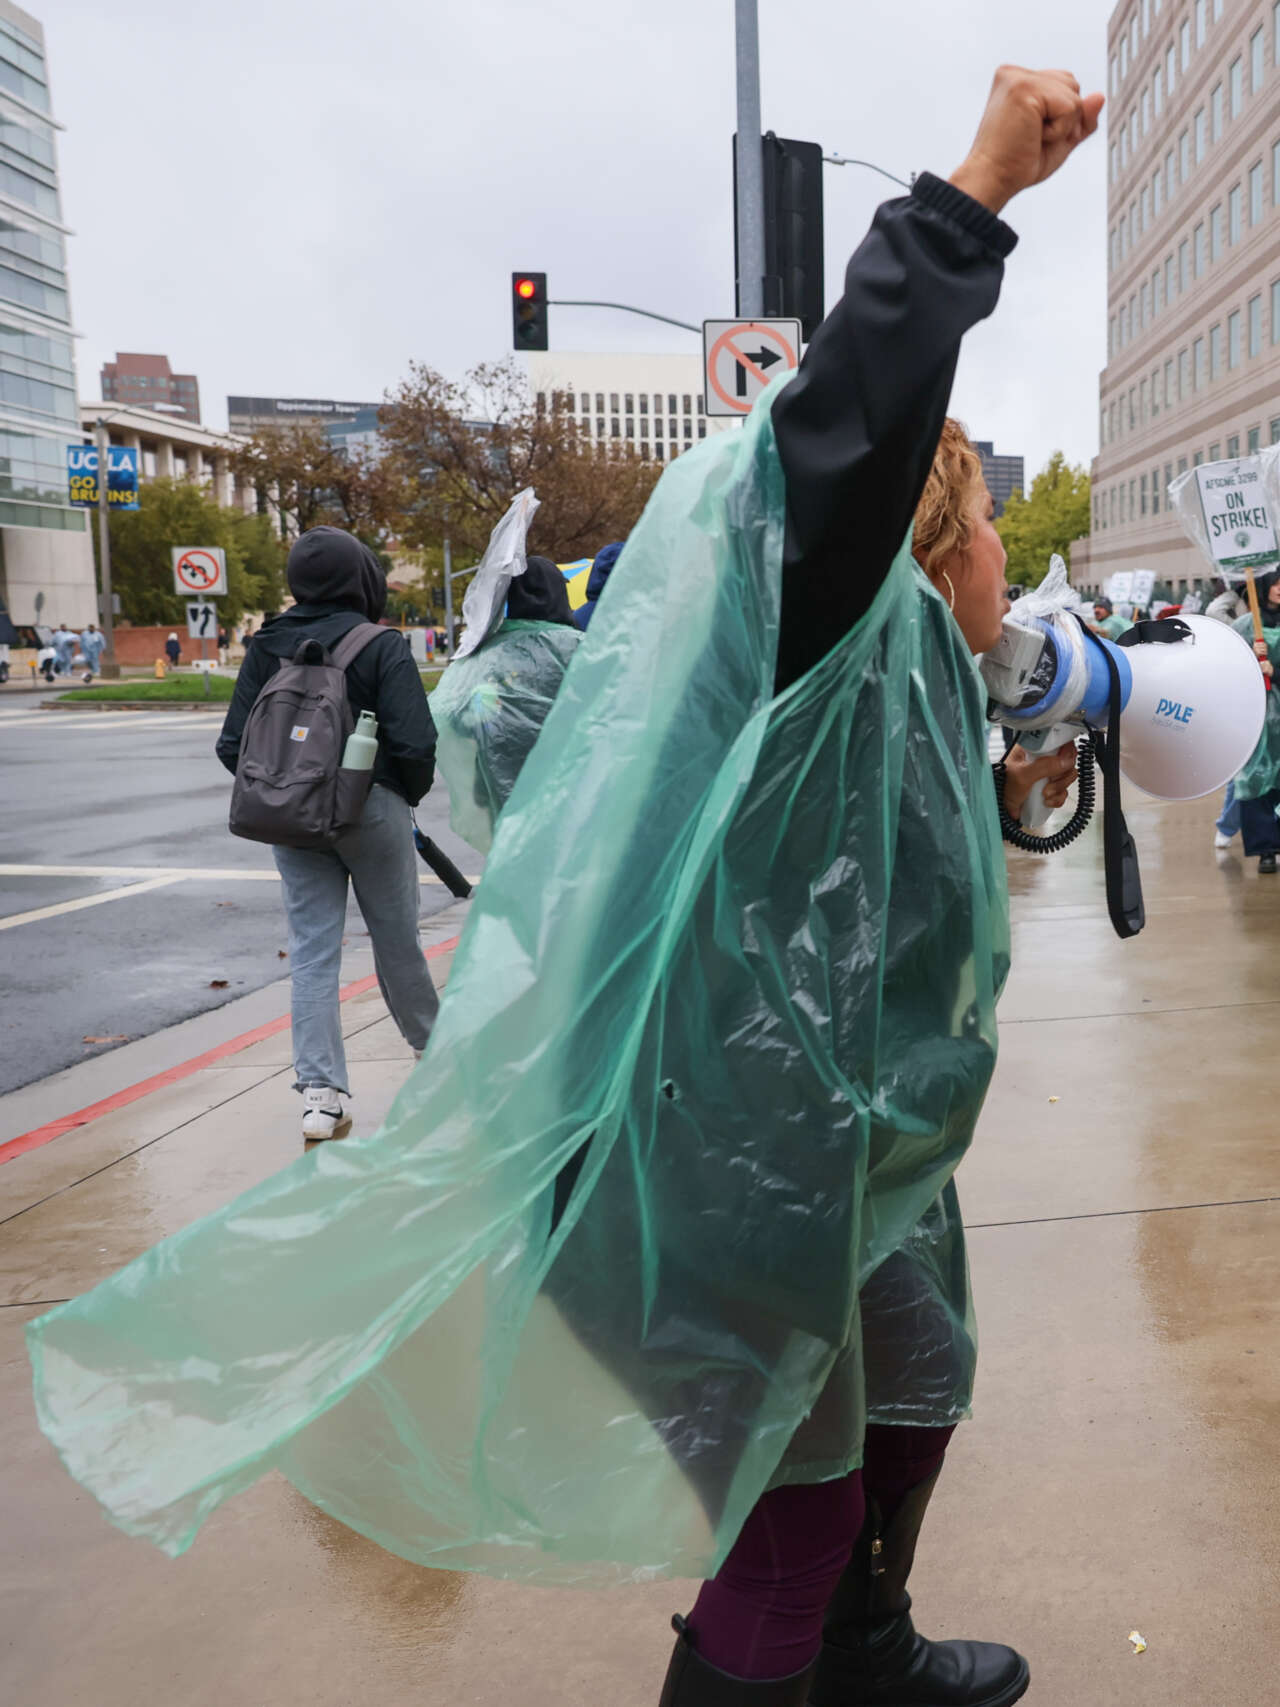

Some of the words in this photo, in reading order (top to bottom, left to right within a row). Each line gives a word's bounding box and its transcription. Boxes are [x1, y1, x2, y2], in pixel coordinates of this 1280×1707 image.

[69, 452, 134, 471] UCLA
[70, 476, 95, 489] GO
[71, 489, 138, 503] BRUINS!
[1225, 491, 1245, 509] ON
[1211, 507, 1268, 537] STRIKE!
[1155, 698, 1193, 723] PYLE
